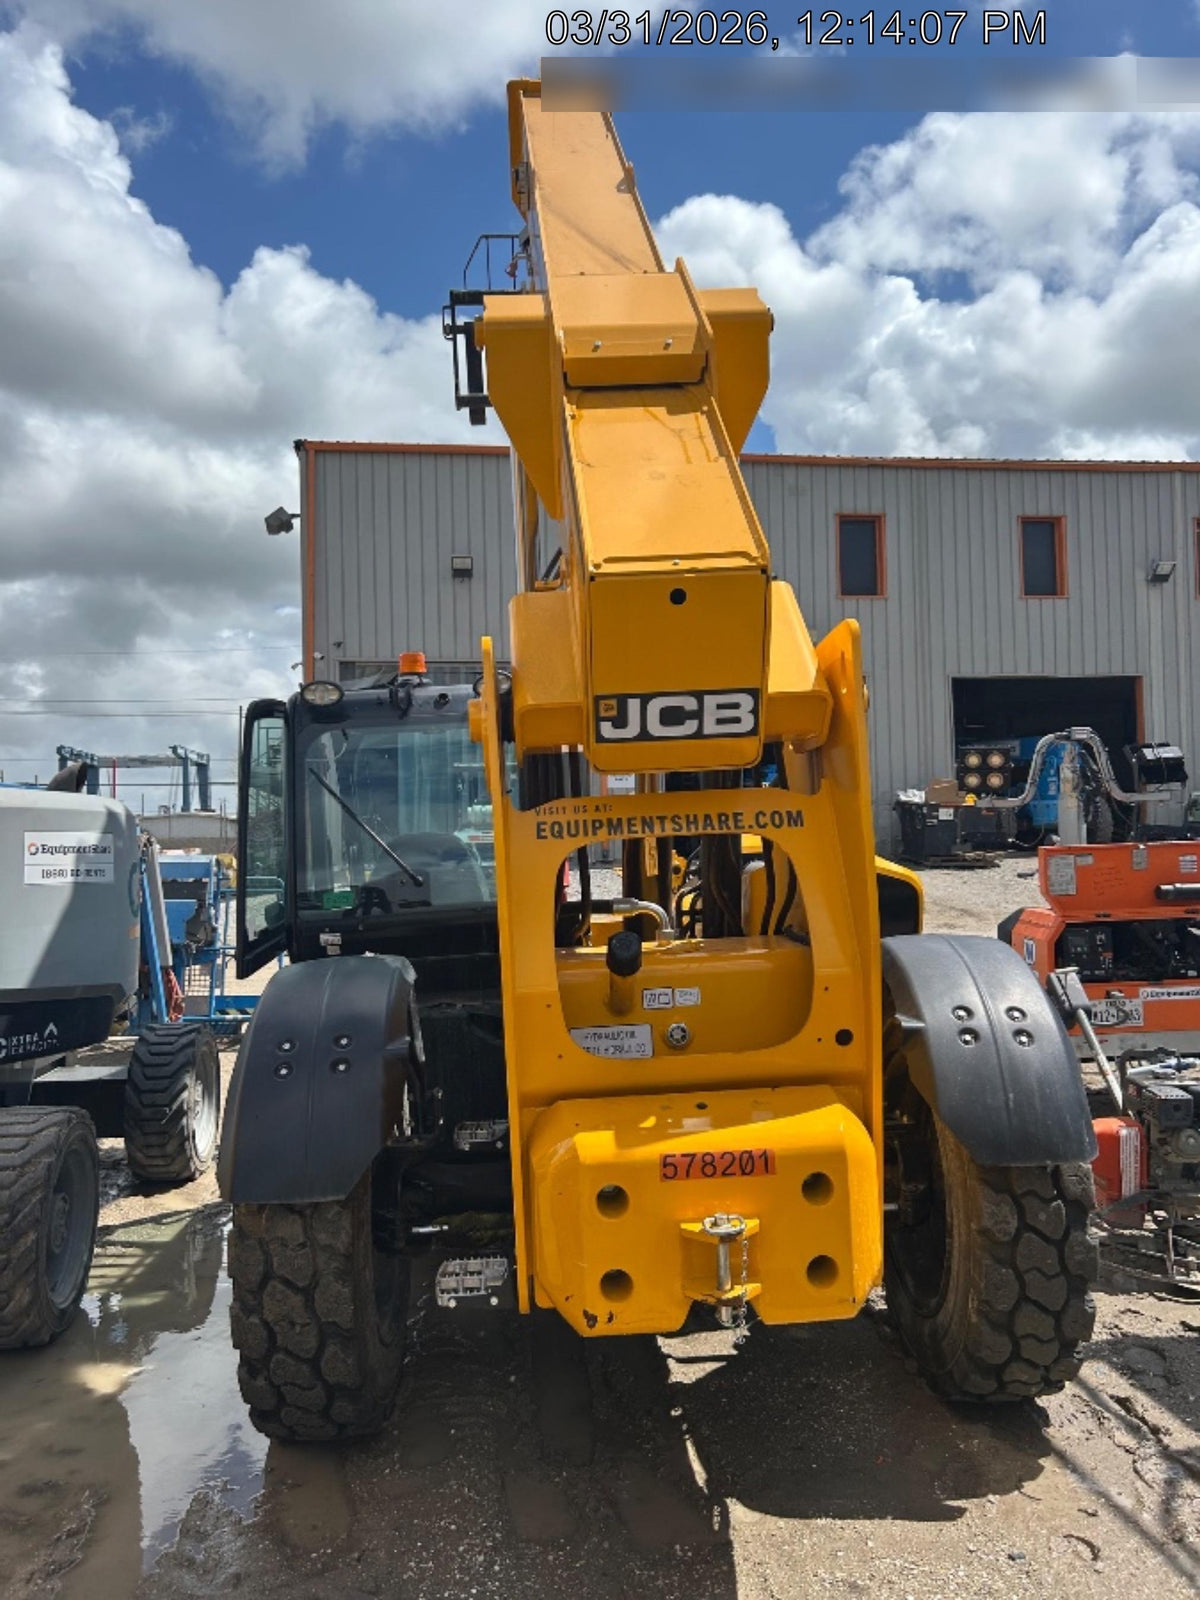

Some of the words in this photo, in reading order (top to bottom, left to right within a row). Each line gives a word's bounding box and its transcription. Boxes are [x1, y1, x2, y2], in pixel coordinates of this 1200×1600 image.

[599, 692, 756, 739] JCB
[535, 806, 567, 817] VISIT
[573, 804, 588, 814] US
[594, 803, 613, 813] AT:
[536, 810, 805, 840] EQUIPMENTSHARE.COM
[662, 1149, 769, 1180] 578201
